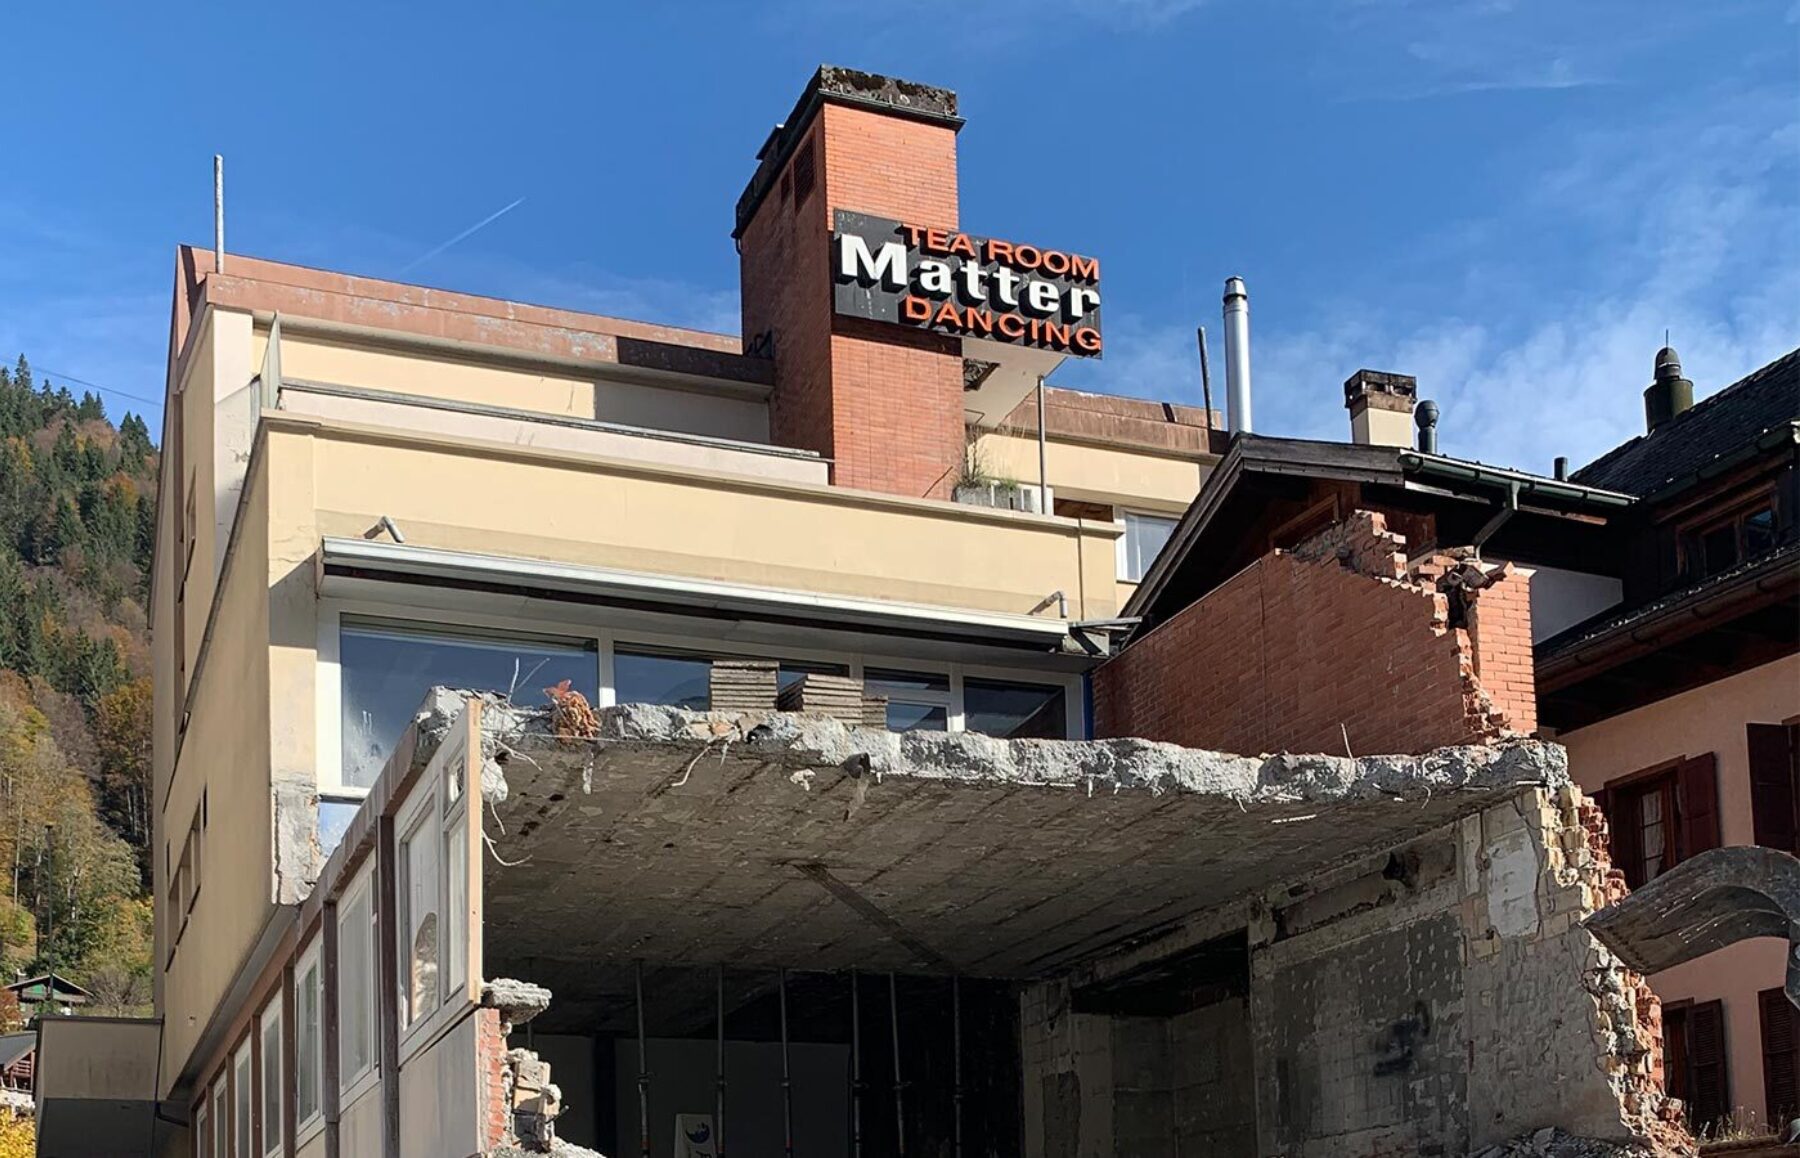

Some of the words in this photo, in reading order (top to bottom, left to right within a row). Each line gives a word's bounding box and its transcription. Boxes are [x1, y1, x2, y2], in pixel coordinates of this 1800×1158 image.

[840, 233, 1101, 318] Matter
[902, 223, 976, 257] TEA
[988, 238, 1099, 280] ROOM
[906, 294, 1101, 350] DANCING
